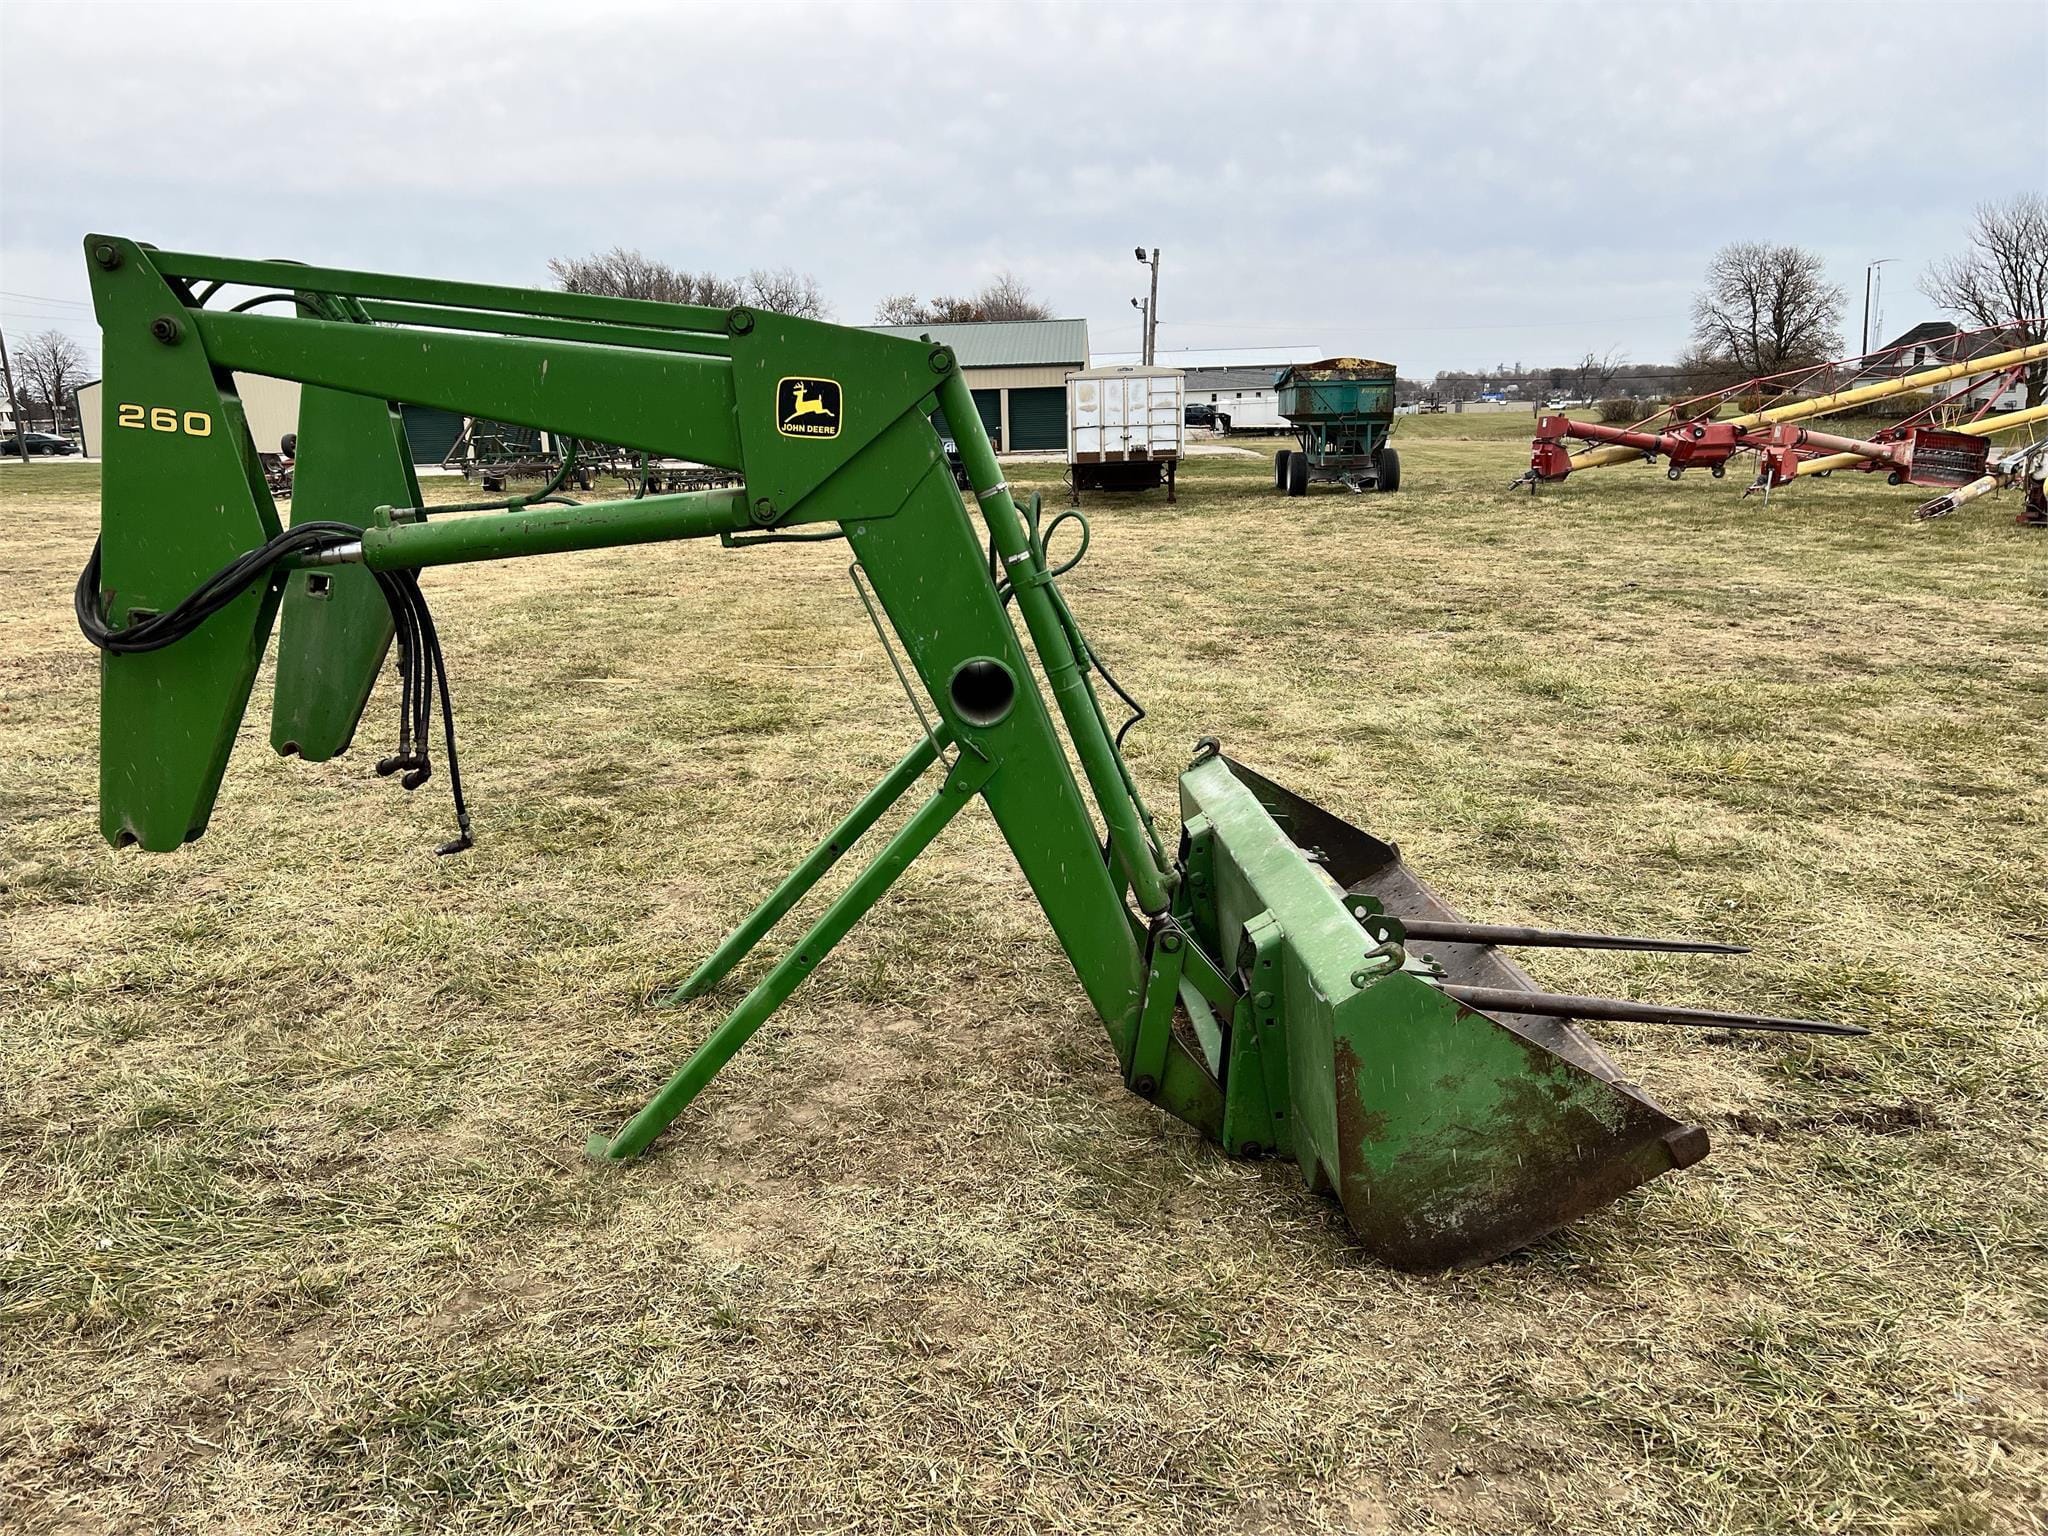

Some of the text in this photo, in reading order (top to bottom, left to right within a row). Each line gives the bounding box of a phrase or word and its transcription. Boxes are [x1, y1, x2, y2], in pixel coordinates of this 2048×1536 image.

[118, 403, 212, 437] 260
[782, 424, 836, 434] JOHN DEERE
